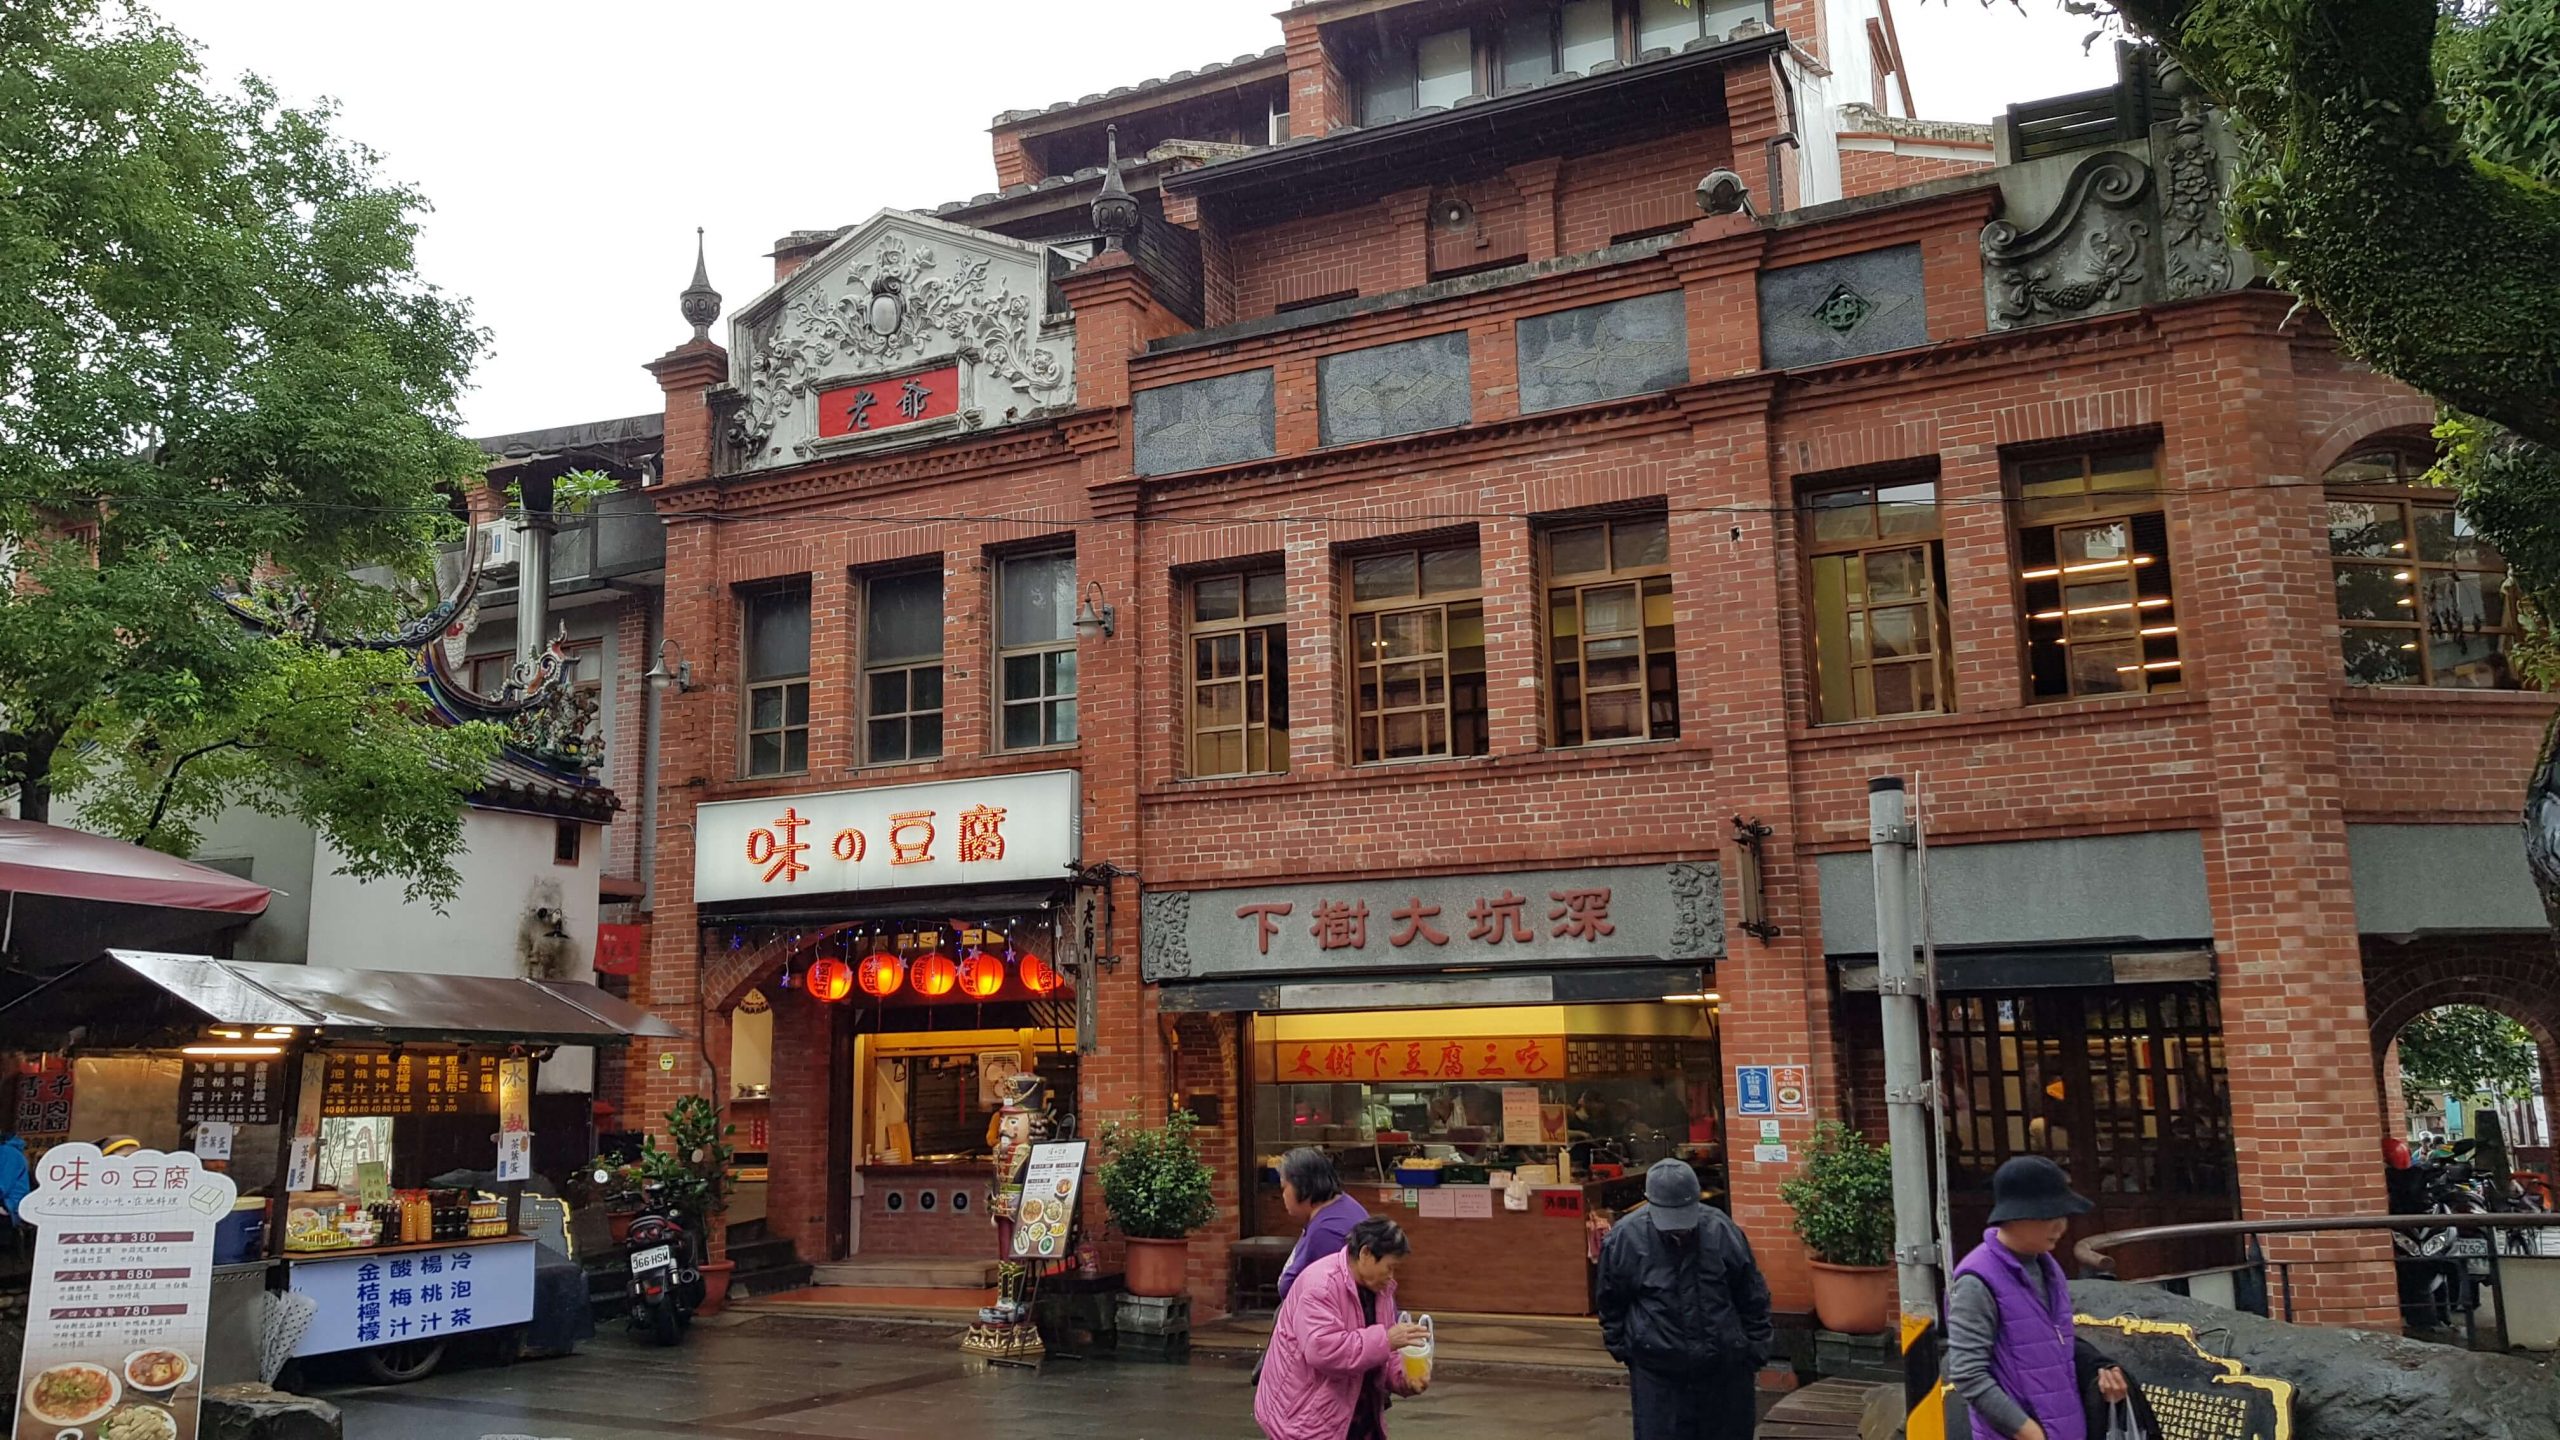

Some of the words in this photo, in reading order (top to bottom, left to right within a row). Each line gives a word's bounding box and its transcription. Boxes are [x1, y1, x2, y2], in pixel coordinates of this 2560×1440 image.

[745, 803, 1008, 882] 味の豆腐
[50, 1156, 190, 1191] 味の豆腐
[126, 1269, 153, 1279] 680
[130, 1233, 156, 1242] 380
[124, 1306, 150, 1316] 780
[357, 1263, 380, 1342] 金桔檸檬
[389, 1260, 412, 1338] 酸梅汁
[420, 1256, 442, 1332] 楊桃汁
[450, 1252, 472, 1327] 冷泡茶
